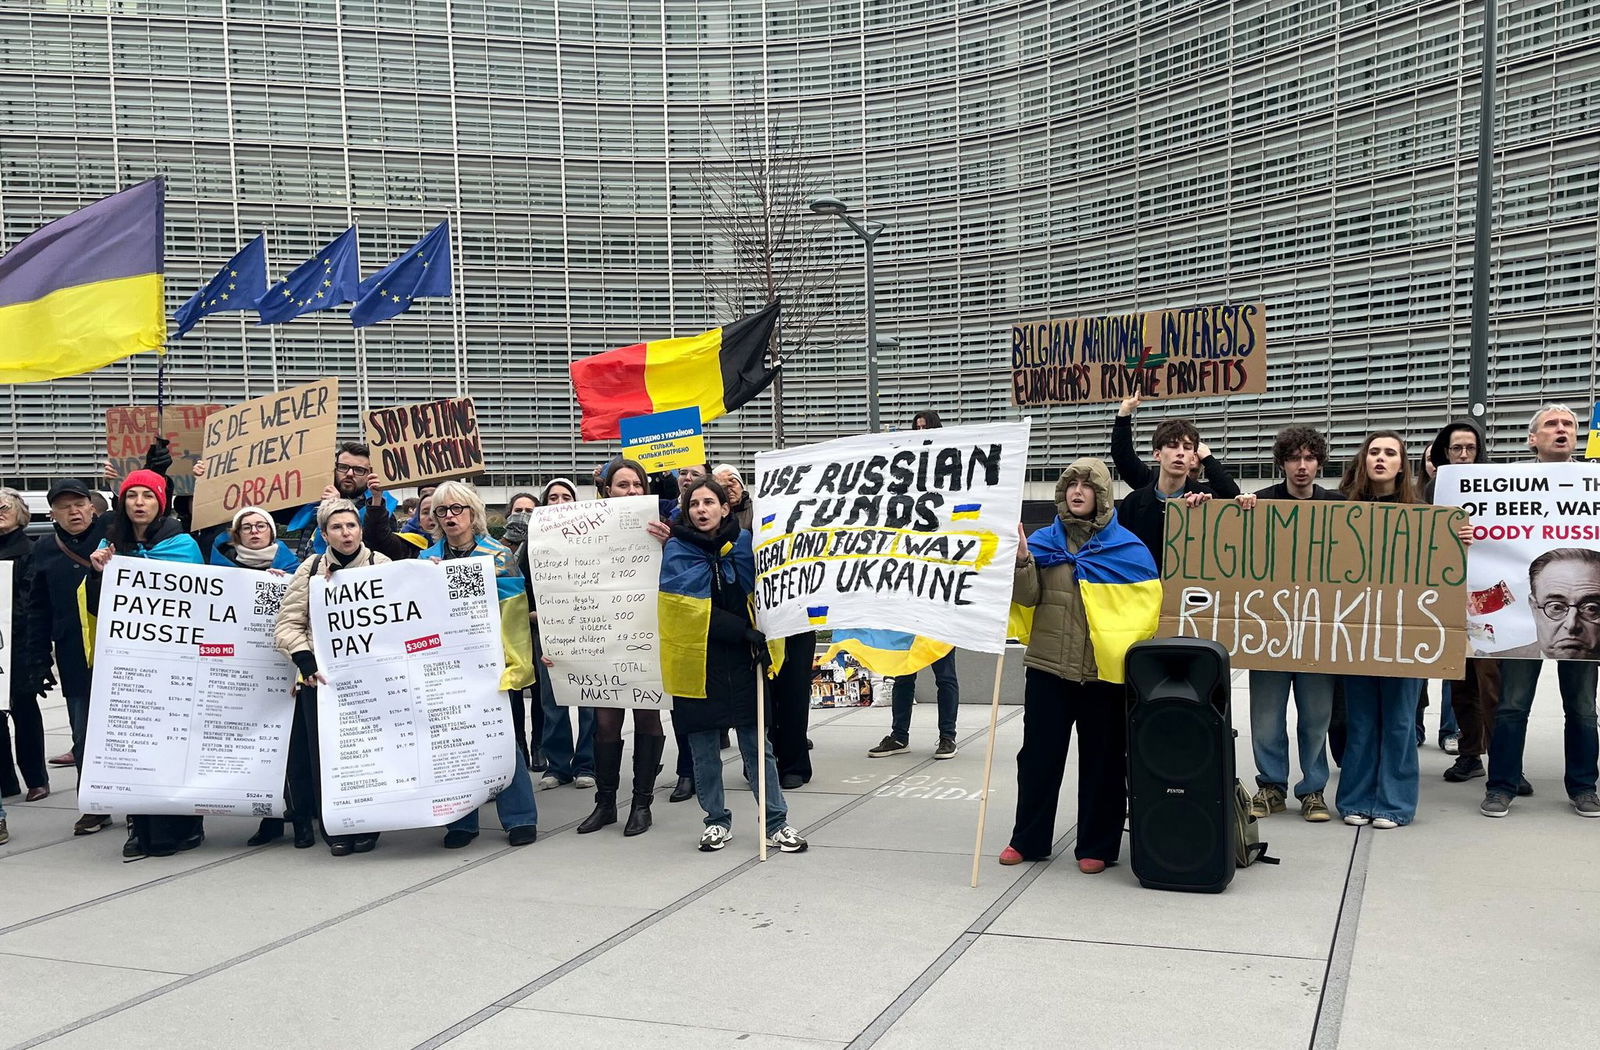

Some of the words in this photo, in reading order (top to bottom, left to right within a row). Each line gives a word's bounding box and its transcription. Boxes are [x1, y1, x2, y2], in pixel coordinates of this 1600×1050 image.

[1012, 320, 1078, 369] BELGIAN
[1081, 312, 1148, 365] NATIONAL
[1161, 304, 1257, 357] INTERESTS
[1101, 364, 1165, 399] PRIVATE
[1167, 359, 1247, 395] PROFITS
[106, 408, 158, 434] FACE
[206, 418, 223, 448] IS
[226, 408, 252, 441] DE
[260, 386, 328, 427] WEVER
[369, 411, 408, 447] STOP
[413, 399, 476, 438] BETTING
[108, 432, 182, 456] CAUE
[639, 434, 660, 443] БУДЕМО
[665, 429, 694, 438] УКРАЇНОЮ
[206, 444, 238, 479] THE
[381, 448, 411, 481] ON
[415, 436, 481, 471] KREMLIN
[638, 451, 661, 460] СКІЛЬКИ
[663, 447, 689, 456] ПОТРІБНО
[758, 464, 811, 499] USE
[814, 440, 1002, 496] RUSSIAN
[1460, 478, 1549, 493] BELGIUM
[785, 492, 944, 533] FUNDS
[1462, 501, 1487, 516] OF
[1496, 501, 1549, 518] BEER,
[1557, 501, 1600, 515] WAF
[568, 535, 610, 544] RECEIPT
[1542, 525, 1599, 540] RUSSI
[755, 539, 786, 575] LEGAL
[790, 533, 827, 560] AND
[828, 531, 896, 556] JUST
[905, 535, 976, 560] WAY
[1163, 502, 1299, 582] BELGIUM
[1307, 503, 1467, 587] HESITATES
[534, 558, 568, 569] Destroyed
[575, 557, 600, 566] houses
[611, 556, 625, 564] 140
[116, 568, 224, 596] FAISONS
[535, 571, 562, 581] Children
[567, 571, 586, 580] killed
[763, 561, 825, 610] DEFEND
[836, 559, 979, 605] UKRAINE
[324, 578, 384, 606] MAKE
[539, 595, 569, 605] Civilians
[611, 595, 621, 603] 20
[627, 594, 646, 602] 000
[113, 594, 192, 618] PAYER
[208, 603, 238, 623] LA
[327, 600, 422, 632] RUSSIA
[542, 616, 564, 625] Victims
[568, 616, 575, 624] of
[614, 611, 634, 620] 500
[109, 620, 204, 645] RUSSIE
[1178, 585, 1321, 661] RUSSIA
[1330, 587, 1445, 664] KILLS
[331, 632, 374, 658] PAY
[406, 640, 427, 651] $300
[428, 637, 440, 645] MD
[545, 635, 575, 645] Kidnapped
[579, 634, 606, 643] children
[199, 645, 221, 655] $300
[222, 646, 234, 655] MD
[571, 647, 605, 656] destroyed
[338, 697, 376, 707] INFRASTRUCTUUR
[581, 689, 624, 701] MUST
[633, 688, 663, 704] PAY
[339, 715, 380, 725] INFRASTRUCTUUR
[429, 720, 466, 729] VERNIETIGING
[340, 777, 378, 787] VERNIETIGING
[432, 793, 472, 803] #MAKERUSSIAPAY
